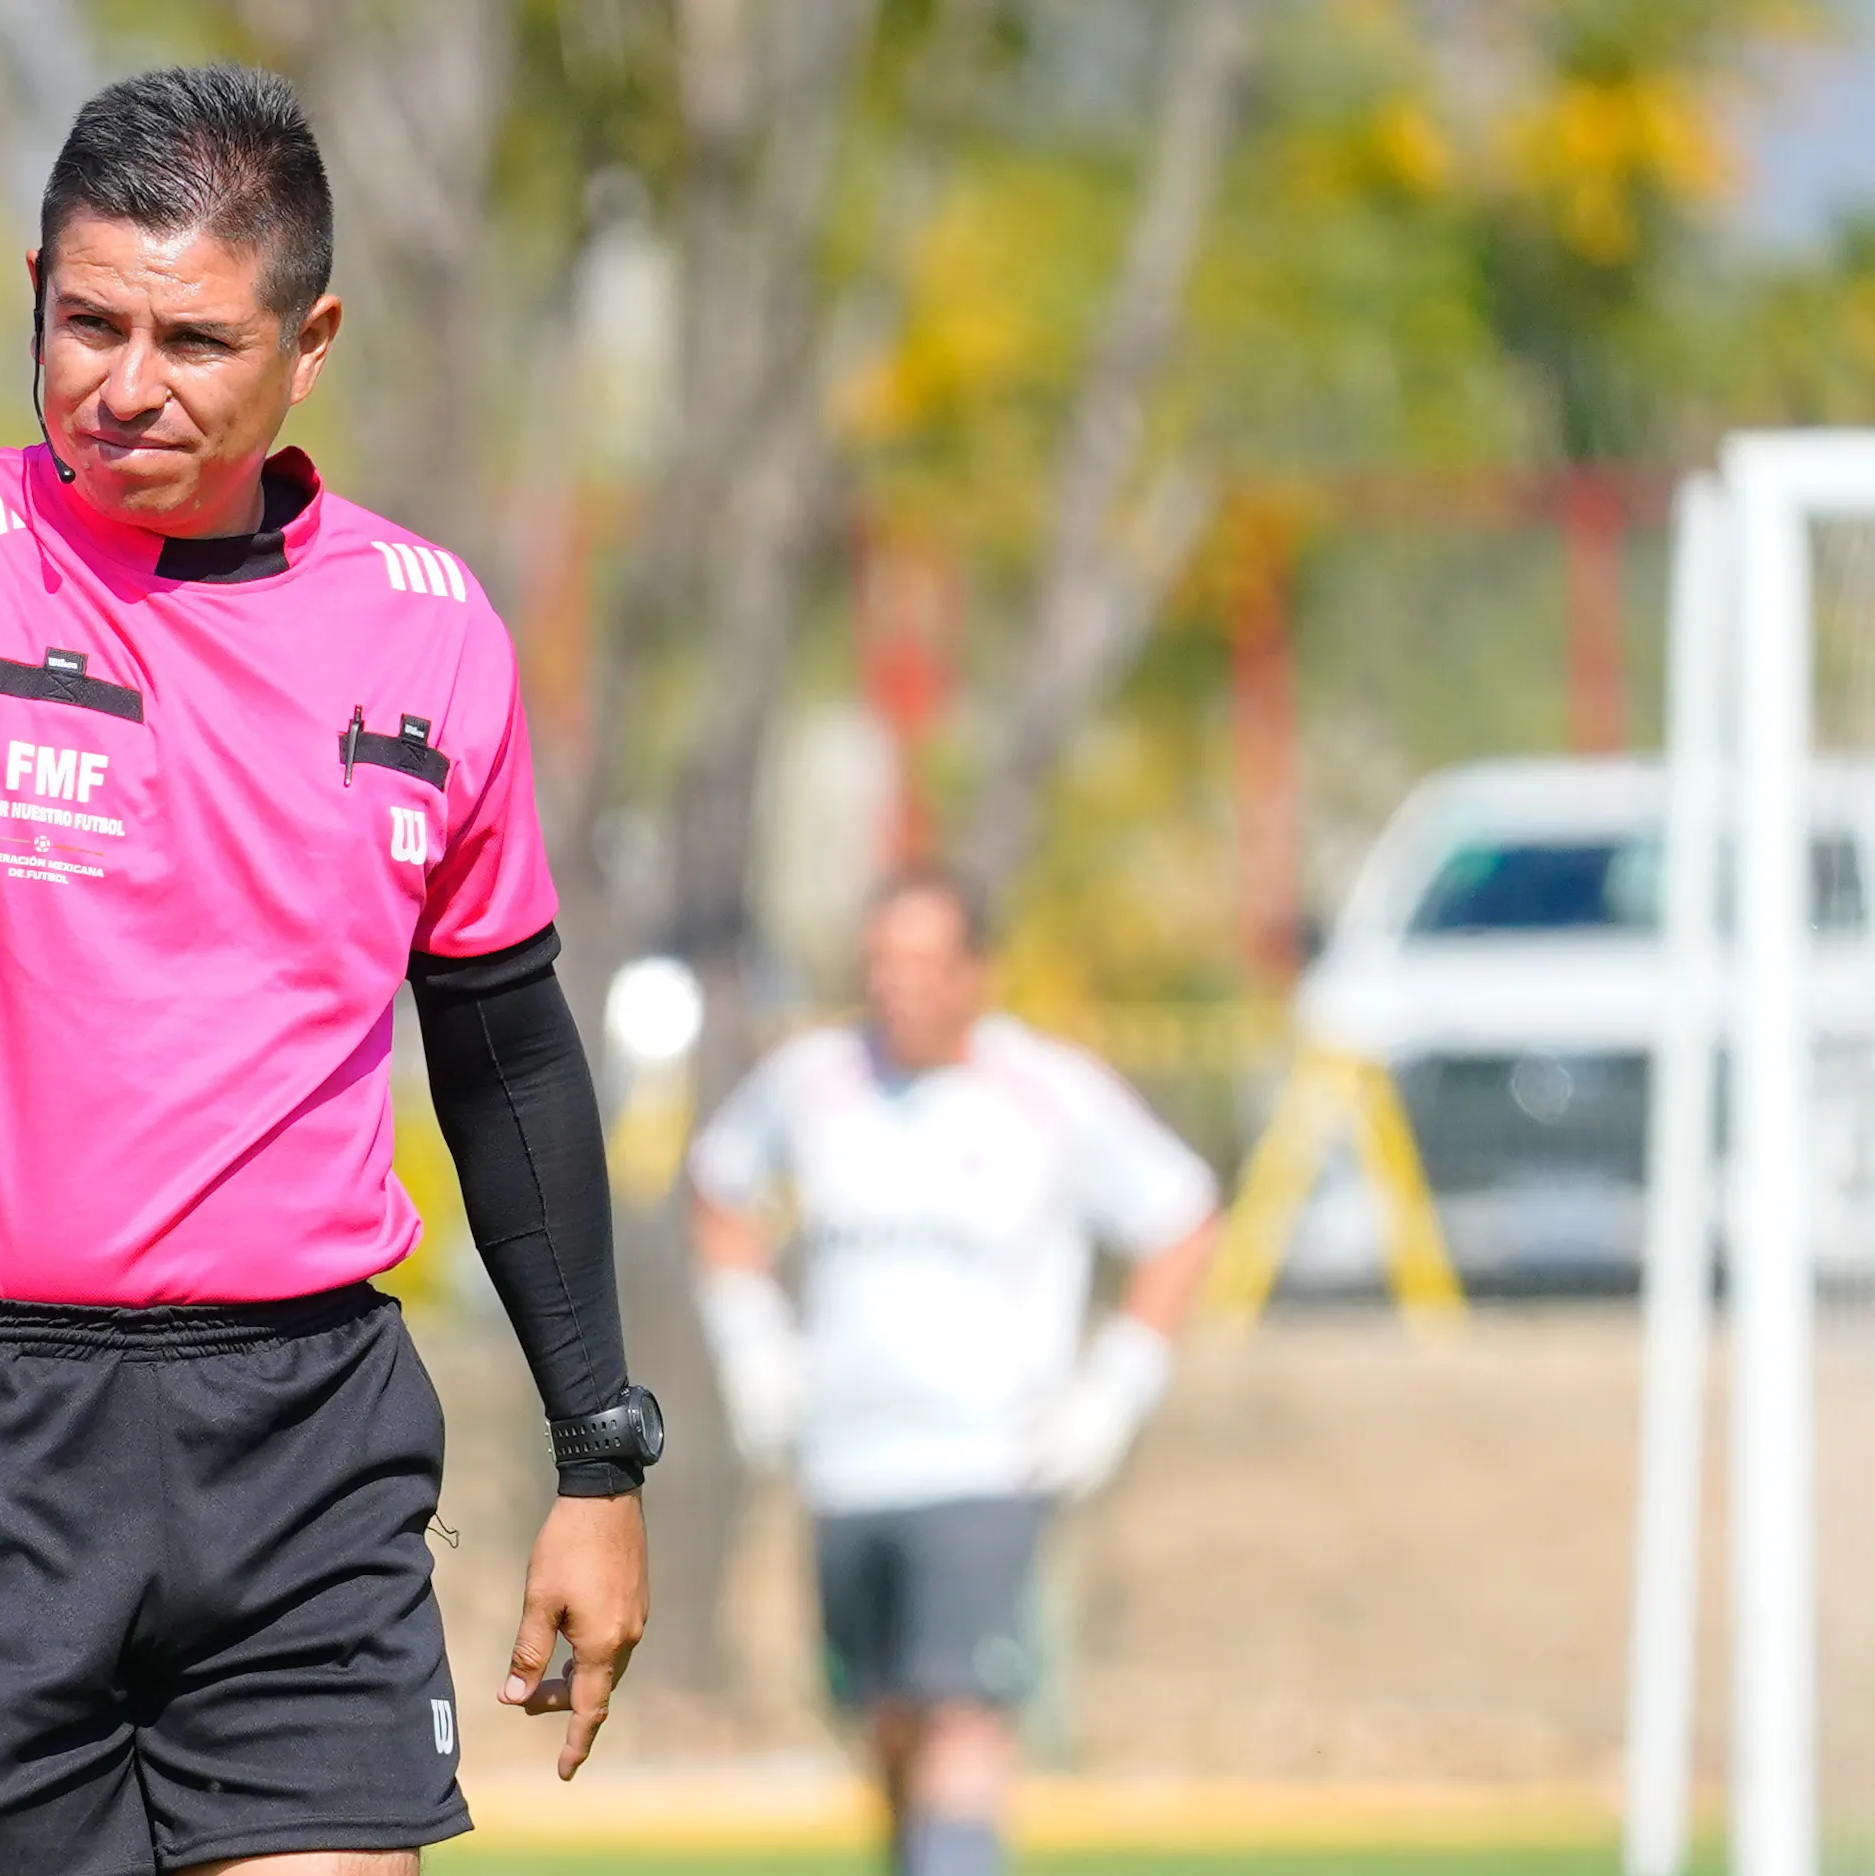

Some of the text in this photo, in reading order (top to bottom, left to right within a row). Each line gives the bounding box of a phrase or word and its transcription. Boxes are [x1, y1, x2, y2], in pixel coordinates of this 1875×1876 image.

[6, 740, 109, 803] FMF
[11, 802, 73, 827] NUESTRO
[74, 813, 125, 837] FUTBOL
[8, 867, 69, 885] DE FUTBOL
[48, 861, 105, 878] MEXICANA
